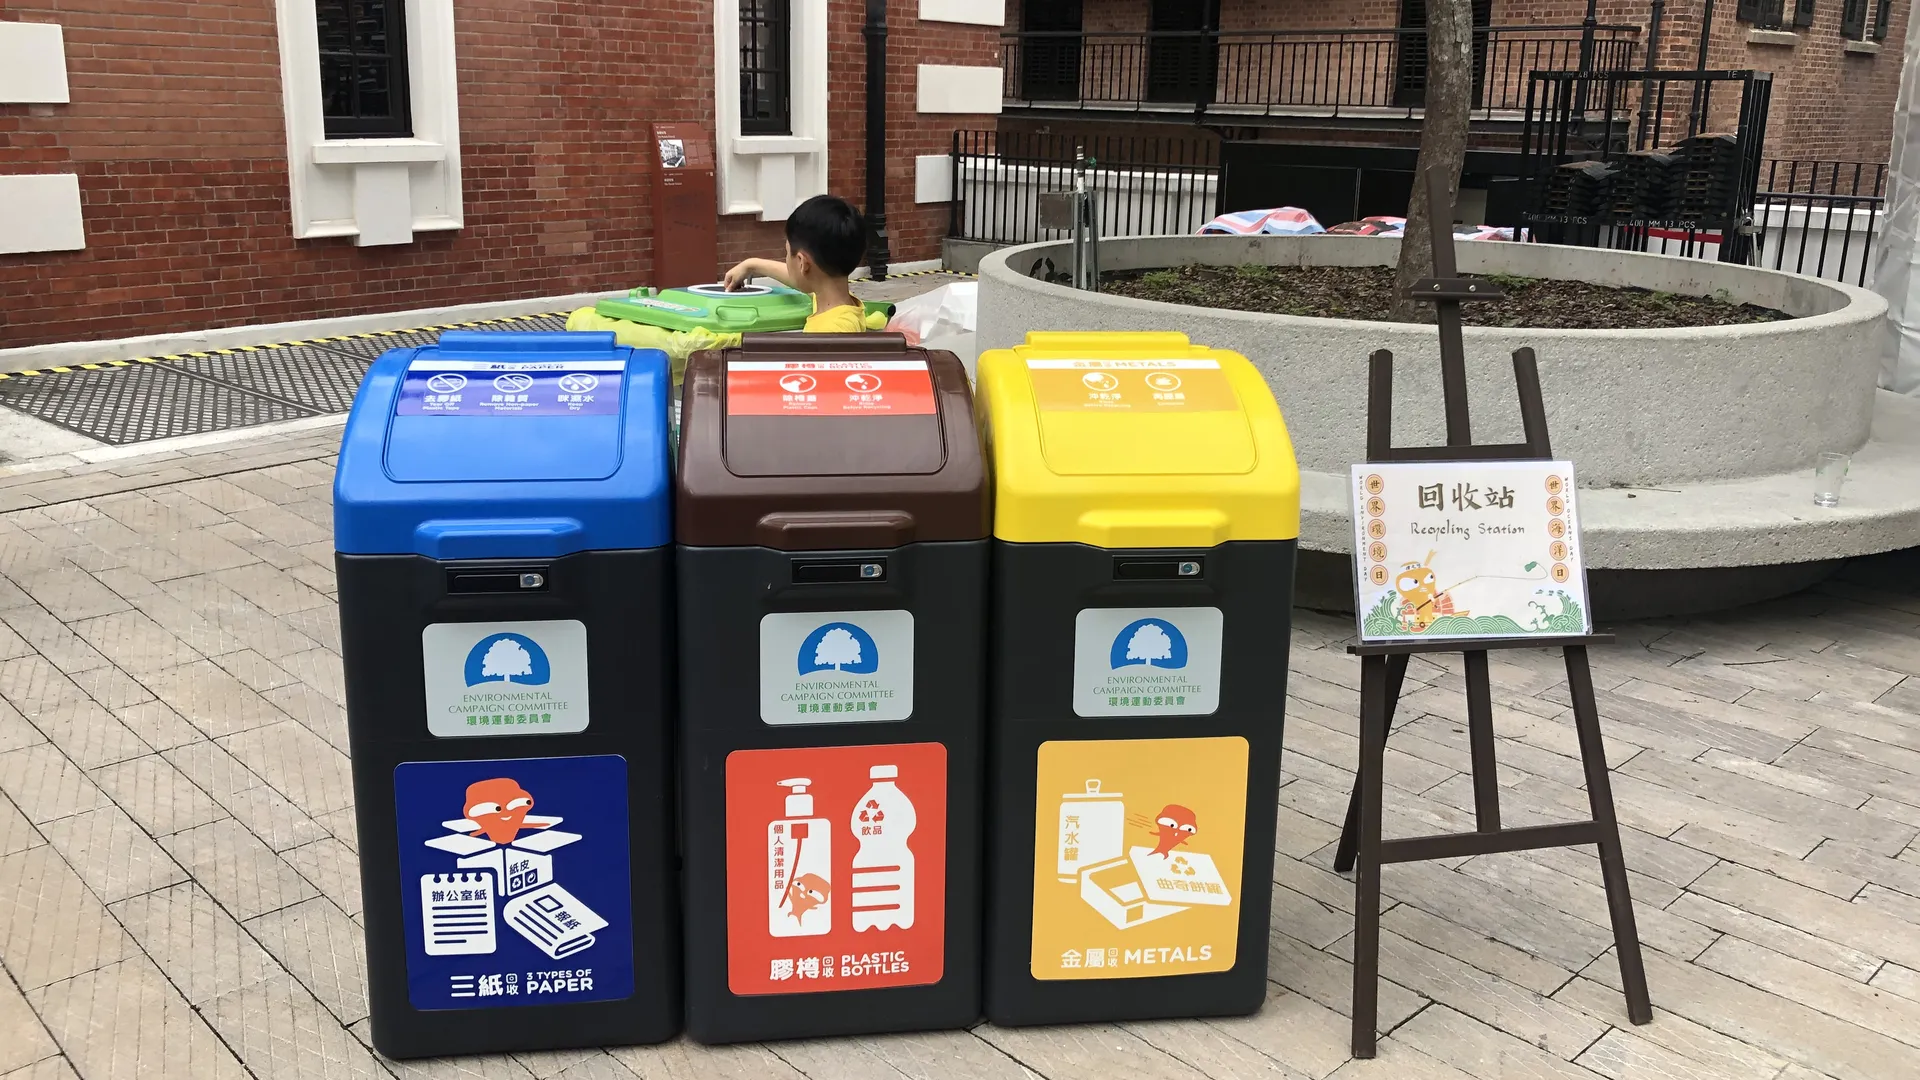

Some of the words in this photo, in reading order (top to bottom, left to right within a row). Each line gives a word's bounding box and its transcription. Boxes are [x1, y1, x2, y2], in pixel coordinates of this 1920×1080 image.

[1648, 220, 1660, 228] MM
[1664, 220, 1674, 228] 13
[1678, 220, 1696, 229] PCS
[1418, 482, 1516, 512] 回收站
[1369, 478, 1385, 581] 世界環境日
[1410, 519, 1471, 541] Recycling
[1478, 522, 1525, 535] Station
[1548, 478, 1565, 579] 世界海洋日
[795, 680, 880, 691] ENVIRONMENTAL
[1107, 675, 1188, 685] ENVIRONMENTAL
[780, 692, 835, 702] CAMPAIGN
[837, 690, 895, 700] COMMITTEE
[1092, 686, 1144, 695] CAMPAIGN
[1146, 685, 1202, 694] COMMITTEE
[463, 692, 552, 703] ENVIRONMENTAL
[1108, 695, 1186, 707] 環境運動委員會
[448, 703, 505, 714] CAMPAIGN
[507, 701, 569, 712] COMMITTEE
[797, 701, 878, 714] 環境運動委員會
[466, 713, 552, 726] 環境運動委員會
[861, 825, 883, 836] 飲品
[1063, 815, 1080, 862] 汽水罐
[773, 824, 785, 890] 個人清潔用品
[509, 859, 530, 875] 紙皮
[432, 889, 487, 902] 辦公室紙
[554, 910, 581, 930] 報紙
[841, 950, 906, 966] PLASTIC
[1124, 945, 1213, 965] METALS
[526, 972, 534, 980] 3
[536, 970, 573, 980] TYPES
[575, 968, 592, 978] OF
[840, 961, 910, 978] BOTTLES
[526, 977, 594, 995] PAPER
